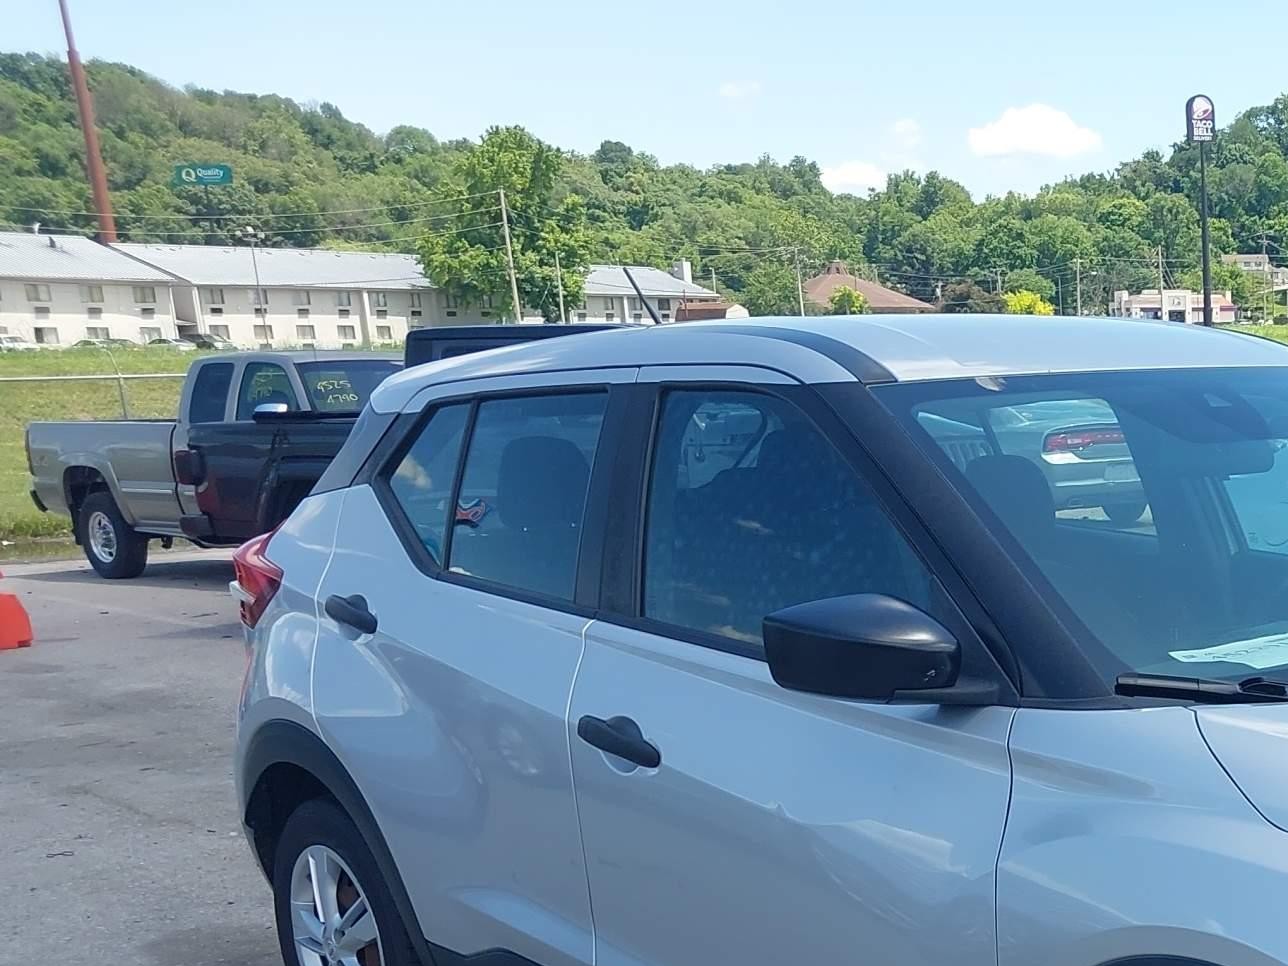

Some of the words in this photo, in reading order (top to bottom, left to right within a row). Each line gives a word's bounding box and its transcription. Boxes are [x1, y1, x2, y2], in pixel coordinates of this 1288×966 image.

[1192, 119, 1213, 128] TACO
[1193, 127, 1213, 136] BELL
[197, 168, 224, 179] Quality
